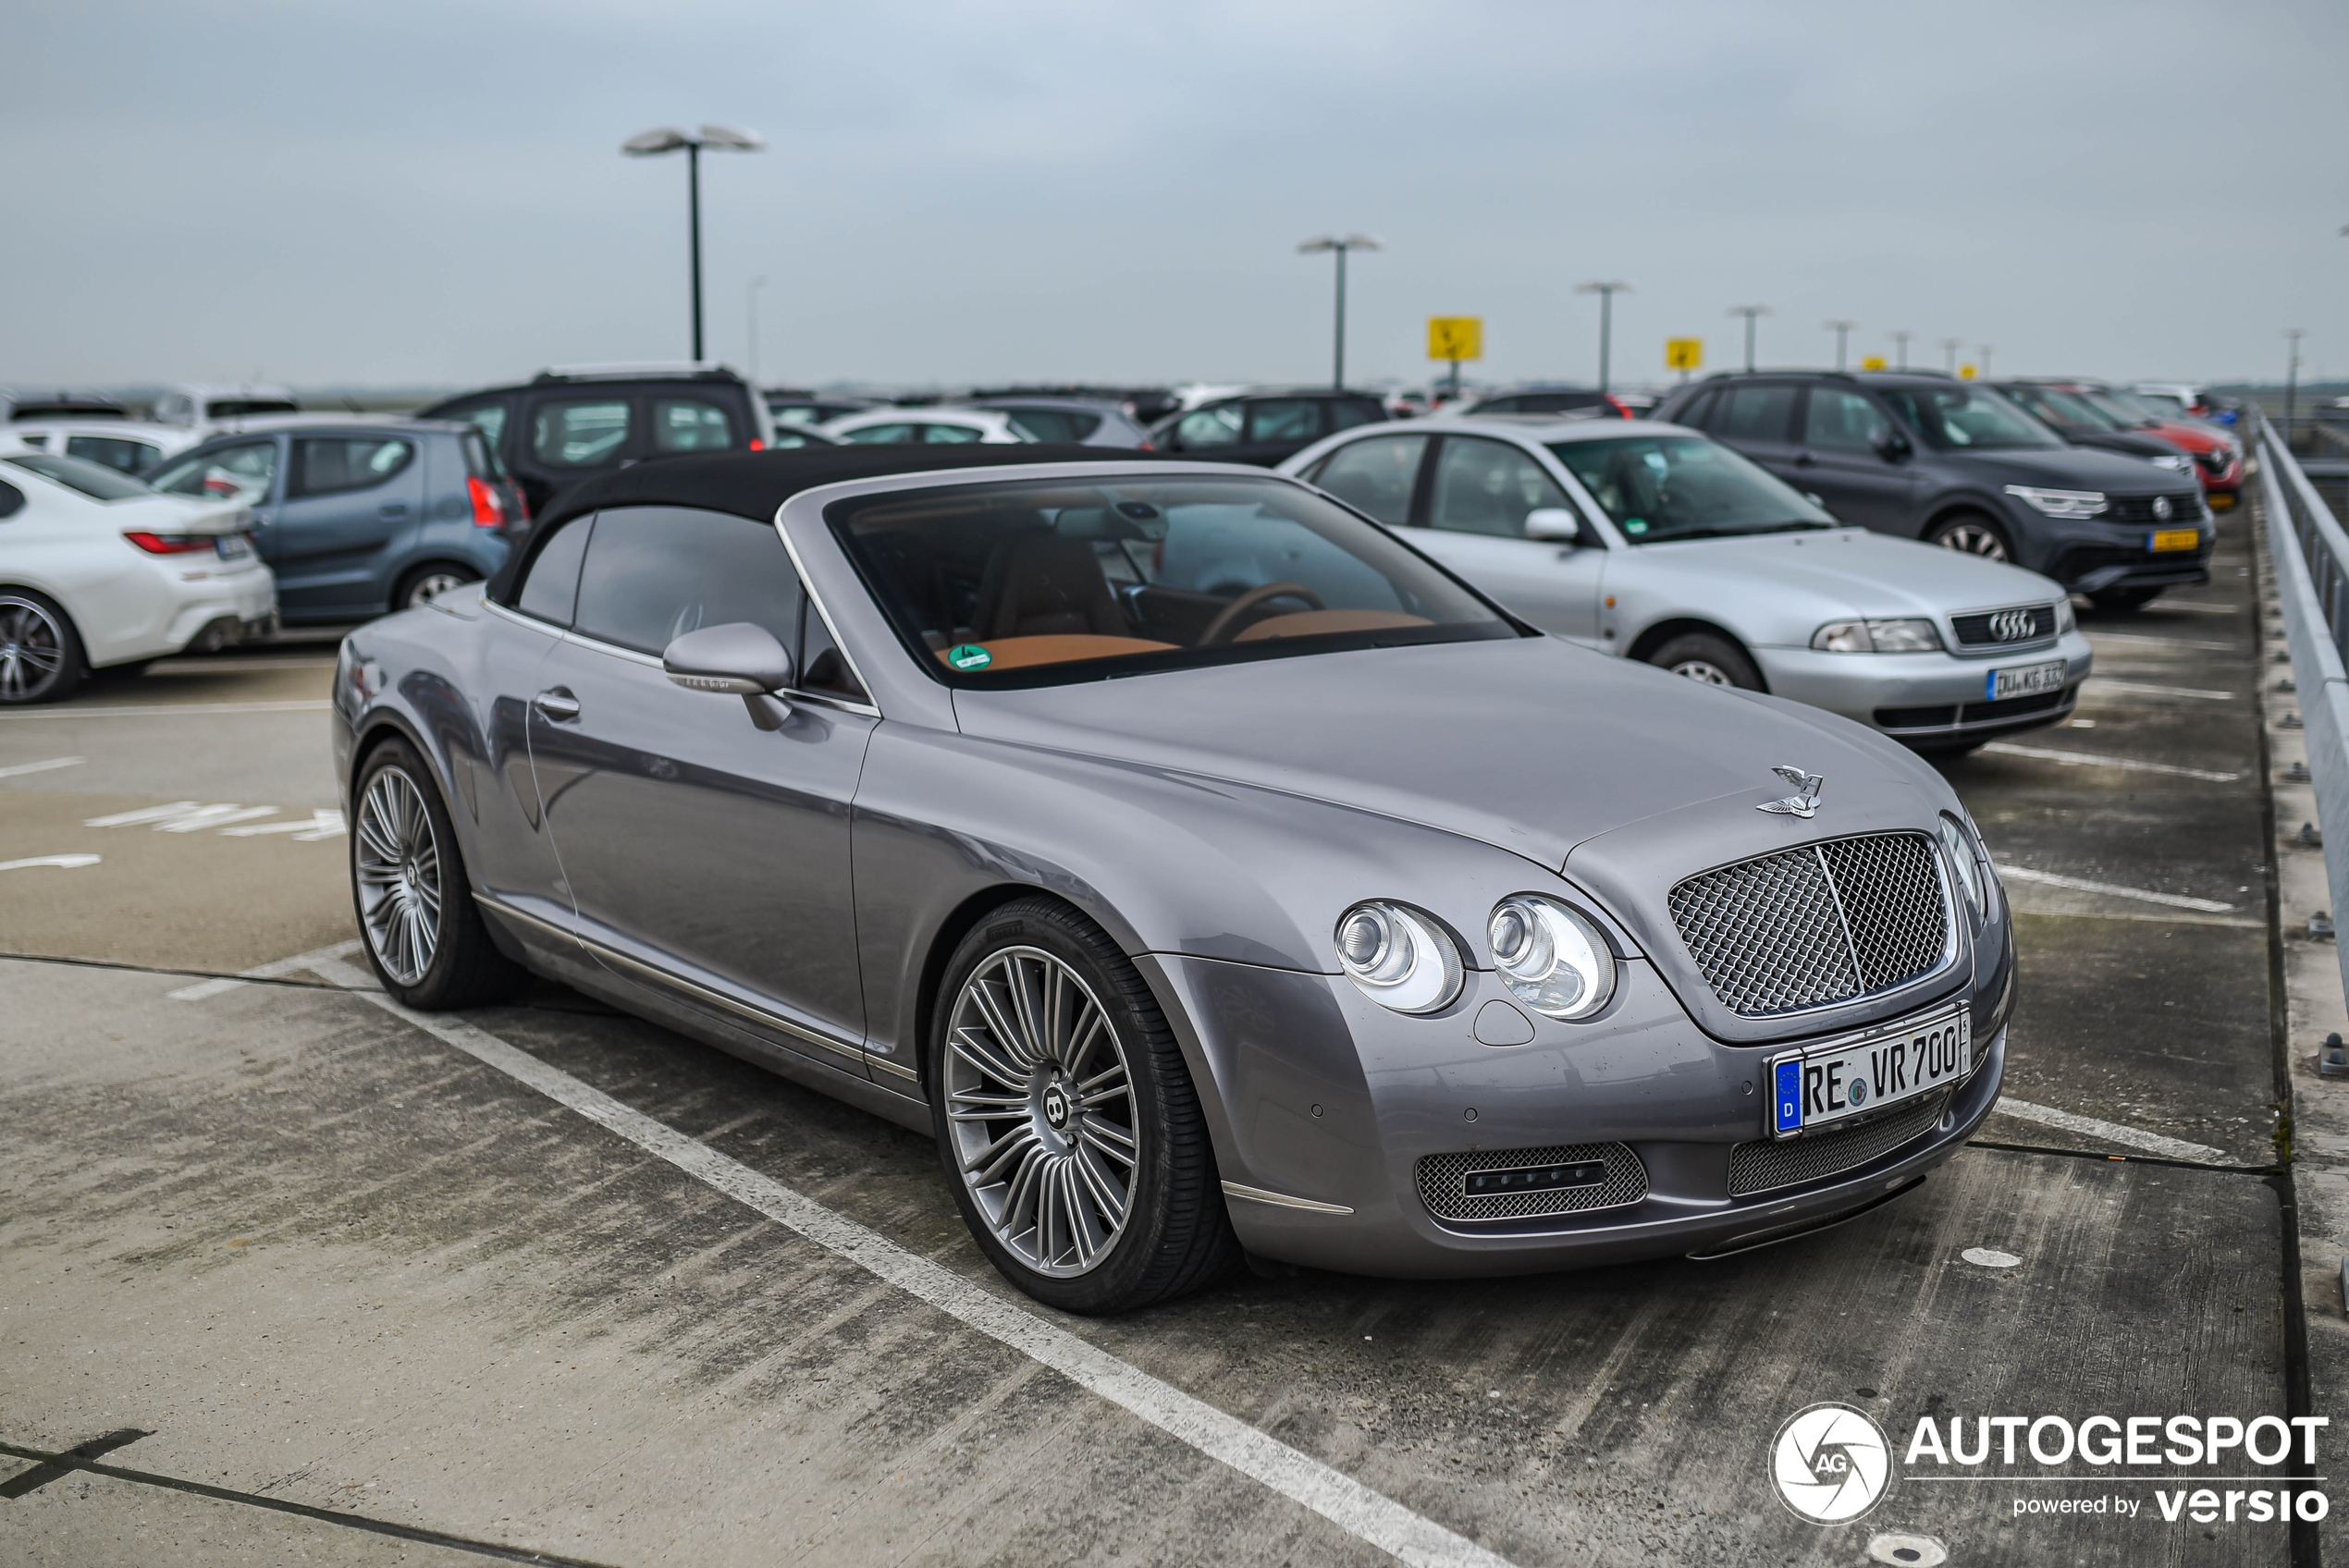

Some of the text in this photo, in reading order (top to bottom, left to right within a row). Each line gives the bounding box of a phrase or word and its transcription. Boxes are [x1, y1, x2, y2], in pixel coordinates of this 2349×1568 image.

[1998, 674, 2016, 694] DU
[2023, 670, 2040, 690] KG
[1784, 1025, 1956, 1118] D RE VR 700
